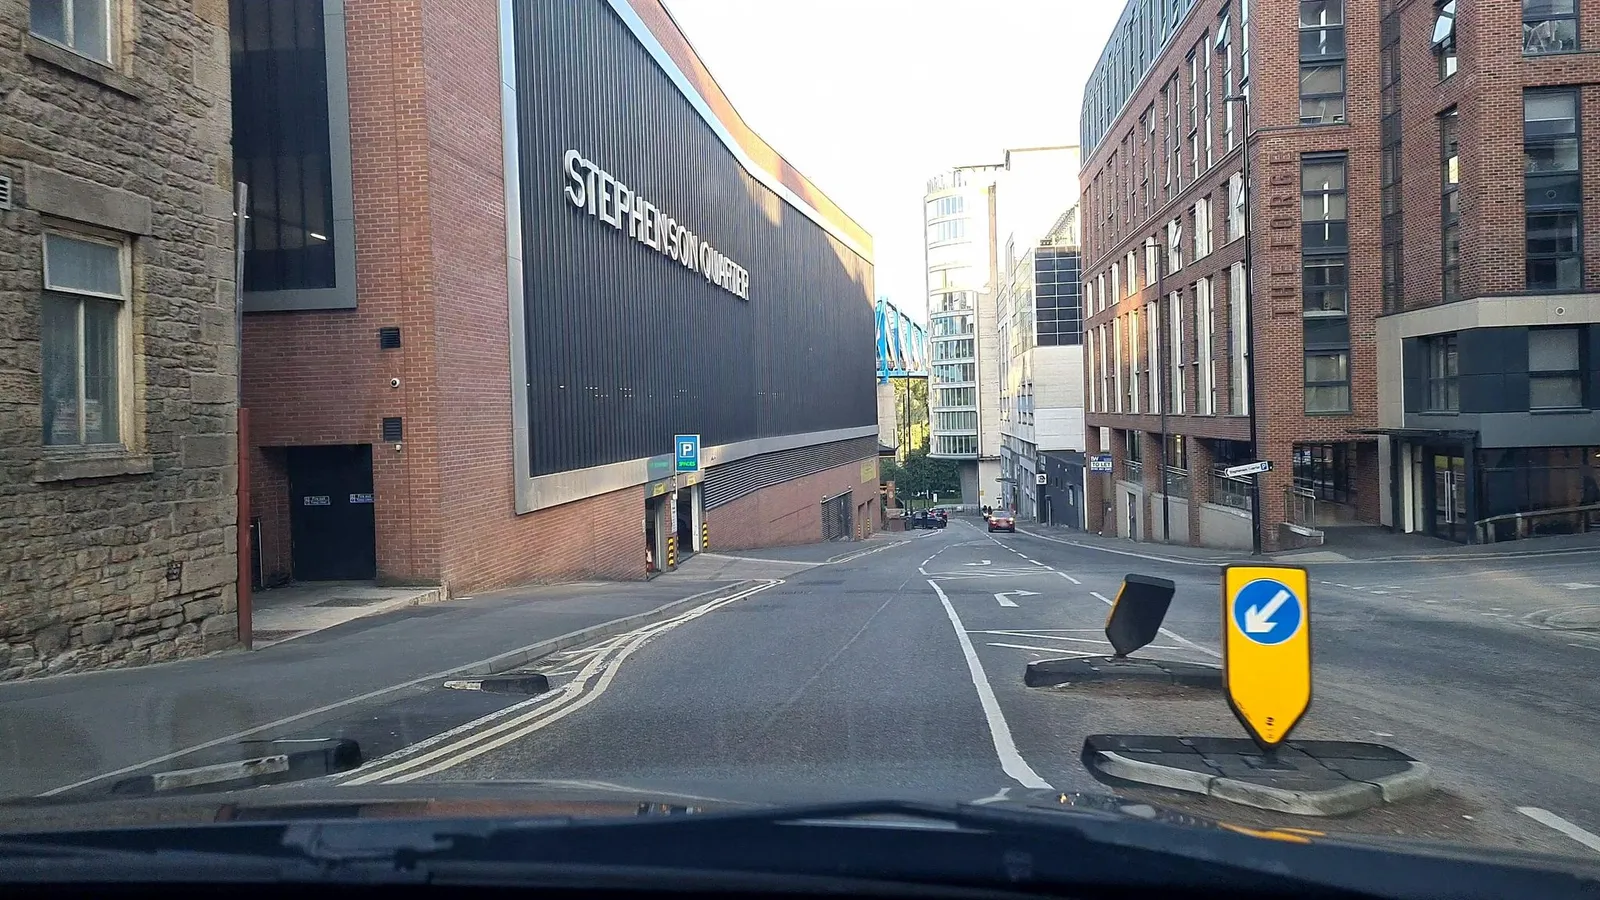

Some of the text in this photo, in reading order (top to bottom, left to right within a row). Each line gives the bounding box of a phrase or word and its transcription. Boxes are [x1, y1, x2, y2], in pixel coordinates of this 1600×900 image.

[565, 149, 749, 300] STEPHENSON QUARTER
[683, 443, 692, 456] P
